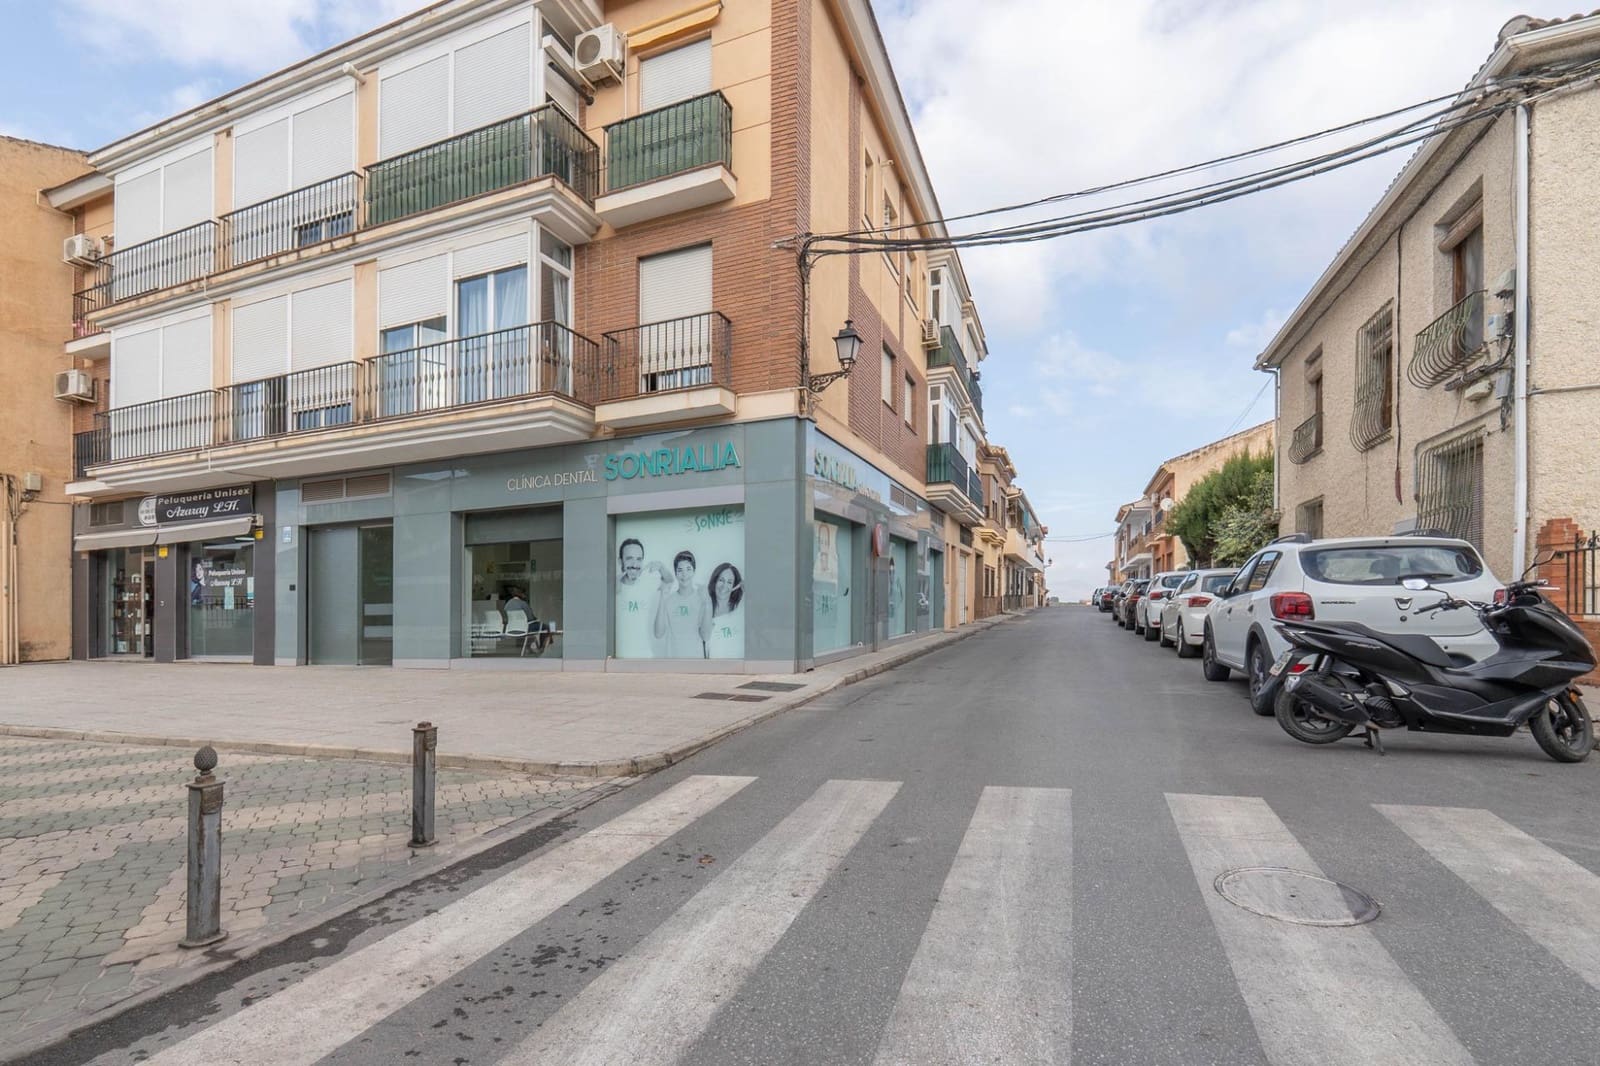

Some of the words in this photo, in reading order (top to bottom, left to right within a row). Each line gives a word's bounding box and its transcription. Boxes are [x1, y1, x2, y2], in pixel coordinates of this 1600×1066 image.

[507, 474, 551, 491] CLÍNICA
[554, 470, 598, 486] DENTAL
[604, 440, 741, 481] SONRIALIA
[214, 488, 250, 498] Unisex
[628, 600, 639, 612] PA
[680, 605, 689, 616] TA
[721, 626, 732, 638] TA
